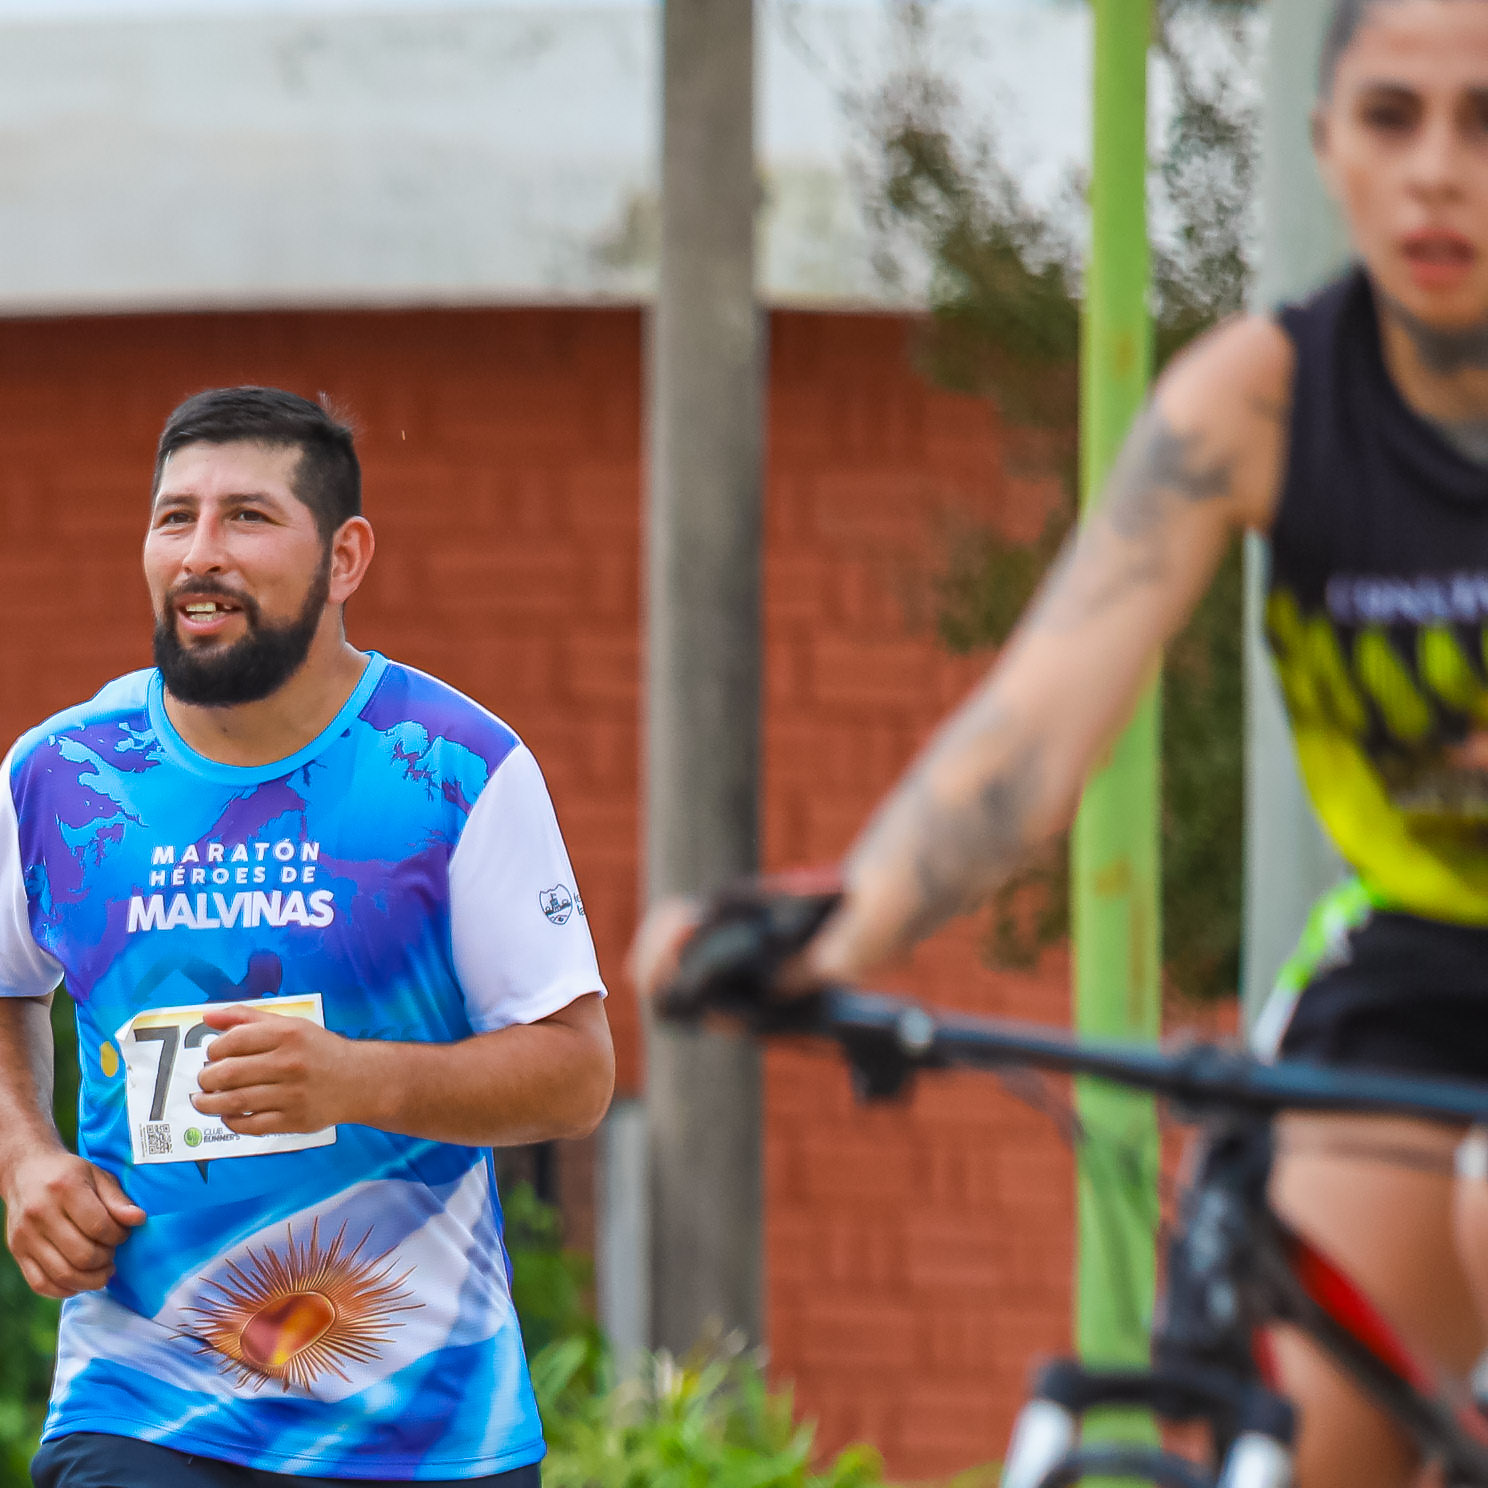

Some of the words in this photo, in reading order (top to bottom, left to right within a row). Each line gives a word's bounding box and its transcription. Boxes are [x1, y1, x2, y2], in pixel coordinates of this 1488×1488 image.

[152, 838, 320, 865] MARATÓN
[149, 865, 266, 887] HÉROES
[281, 866, 316, 884] DE
[127, 889, 334, 933] MALVINAS
[203, 1127, 223, 1136] CLUB
